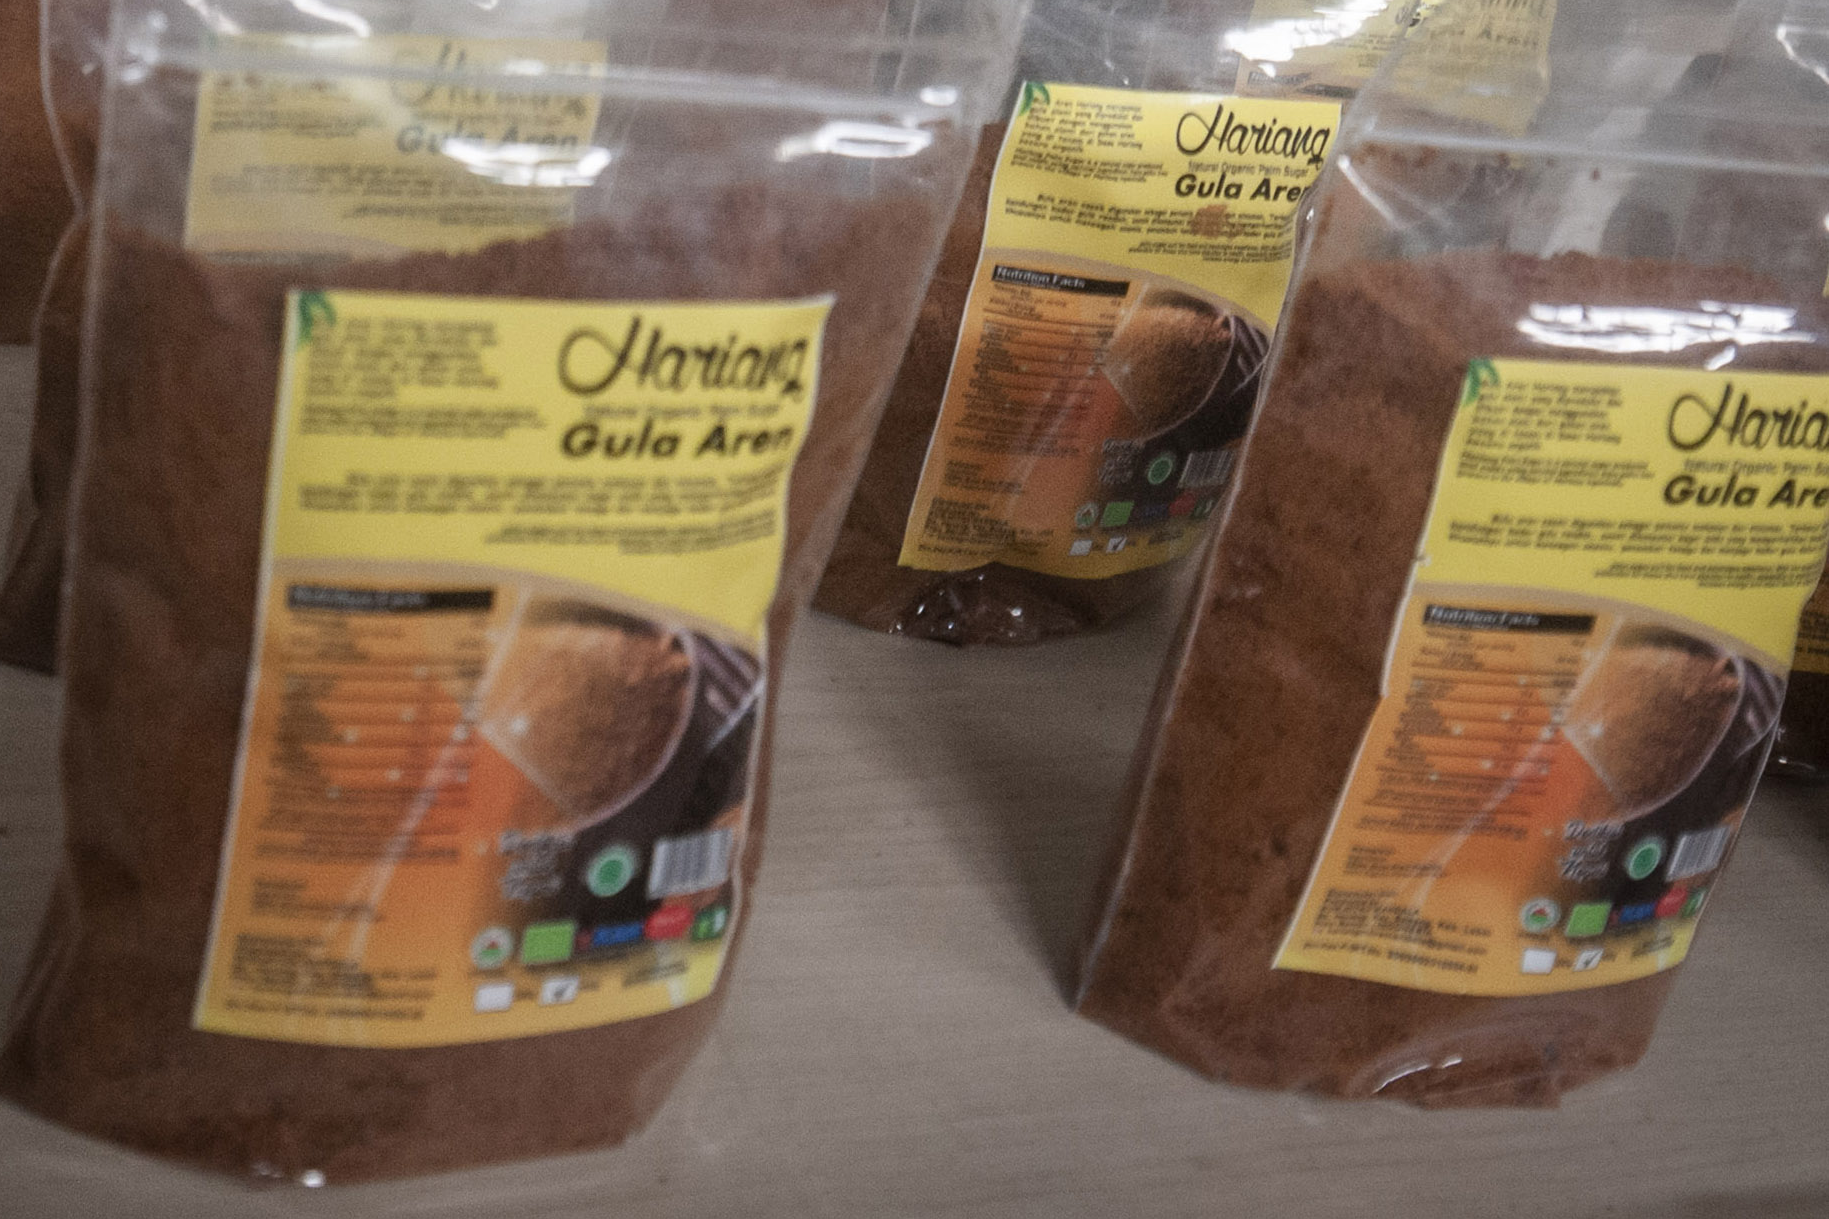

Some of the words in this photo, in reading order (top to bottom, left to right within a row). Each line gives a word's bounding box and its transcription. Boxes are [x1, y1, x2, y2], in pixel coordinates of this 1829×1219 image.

[1176, 103, 1332, 171] Hariang
[1175, 172, 1243, 200] Gula
[1188, 160, 1219, 173] Natural
[1221, 161, 1257, 176] Organic
[1667, 381, 1829, 452] Haria
[559, 418, 681, 460] Gula
[695, 423, 793, 457] Aren
[1664, 472, 1760, 508] Gula
[1767, 479, 1829, 509] Are
